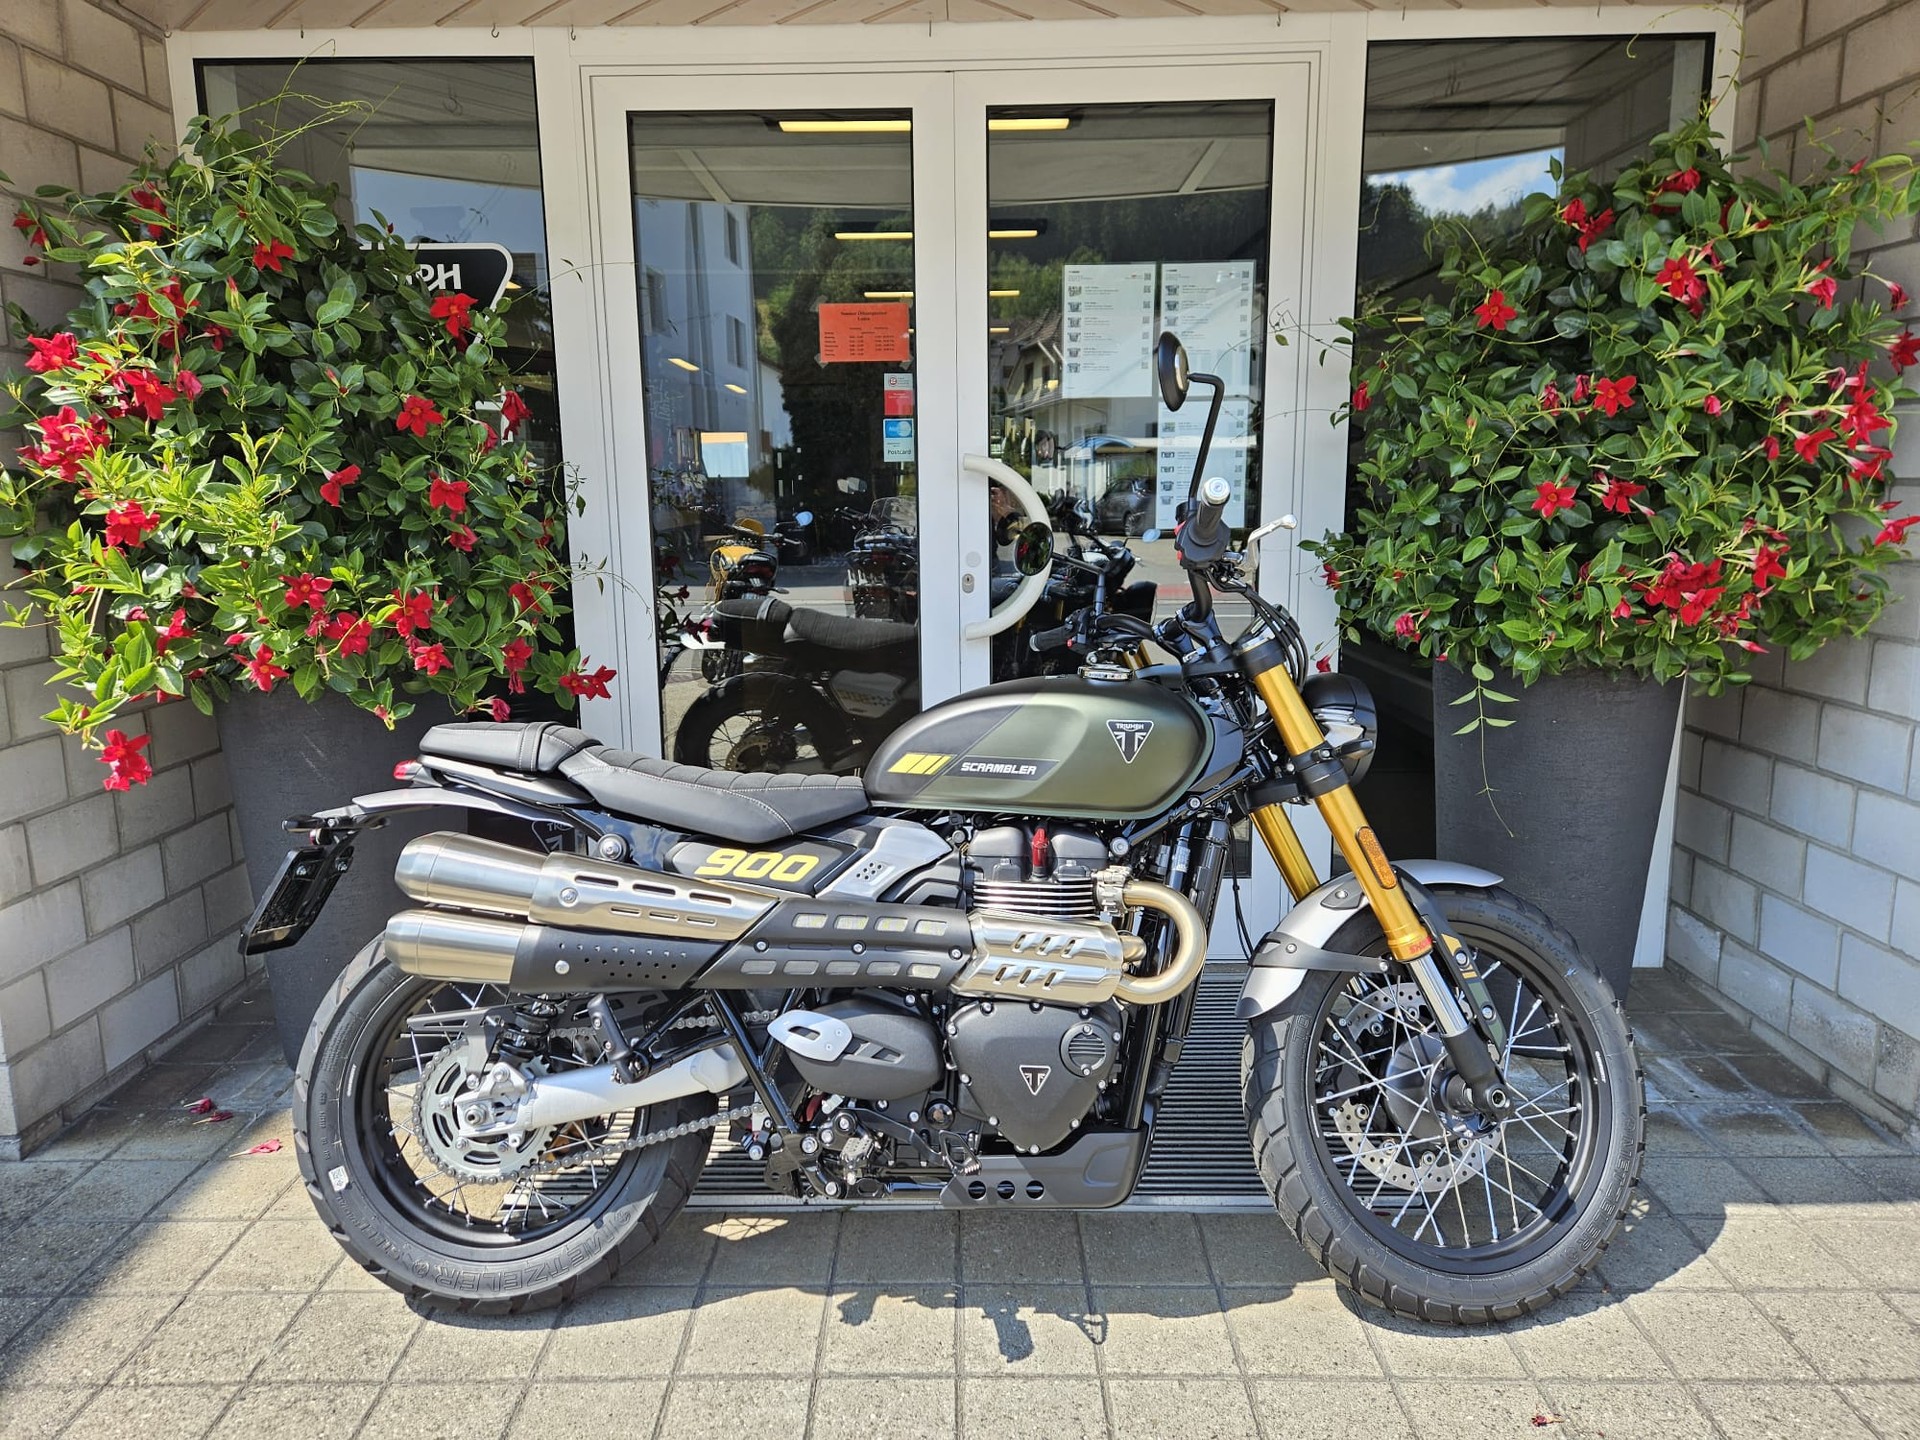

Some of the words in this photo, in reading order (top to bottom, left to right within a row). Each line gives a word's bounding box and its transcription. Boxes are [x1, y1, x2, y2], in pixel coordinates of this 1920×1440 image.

[1115, 722, 1145, 730] TRIUMPH
[960, 762, 1037, 775] SCRAMBLER
[694, 848, 819, 882] 900
[434, 1220, 616, 1292] METZELER
